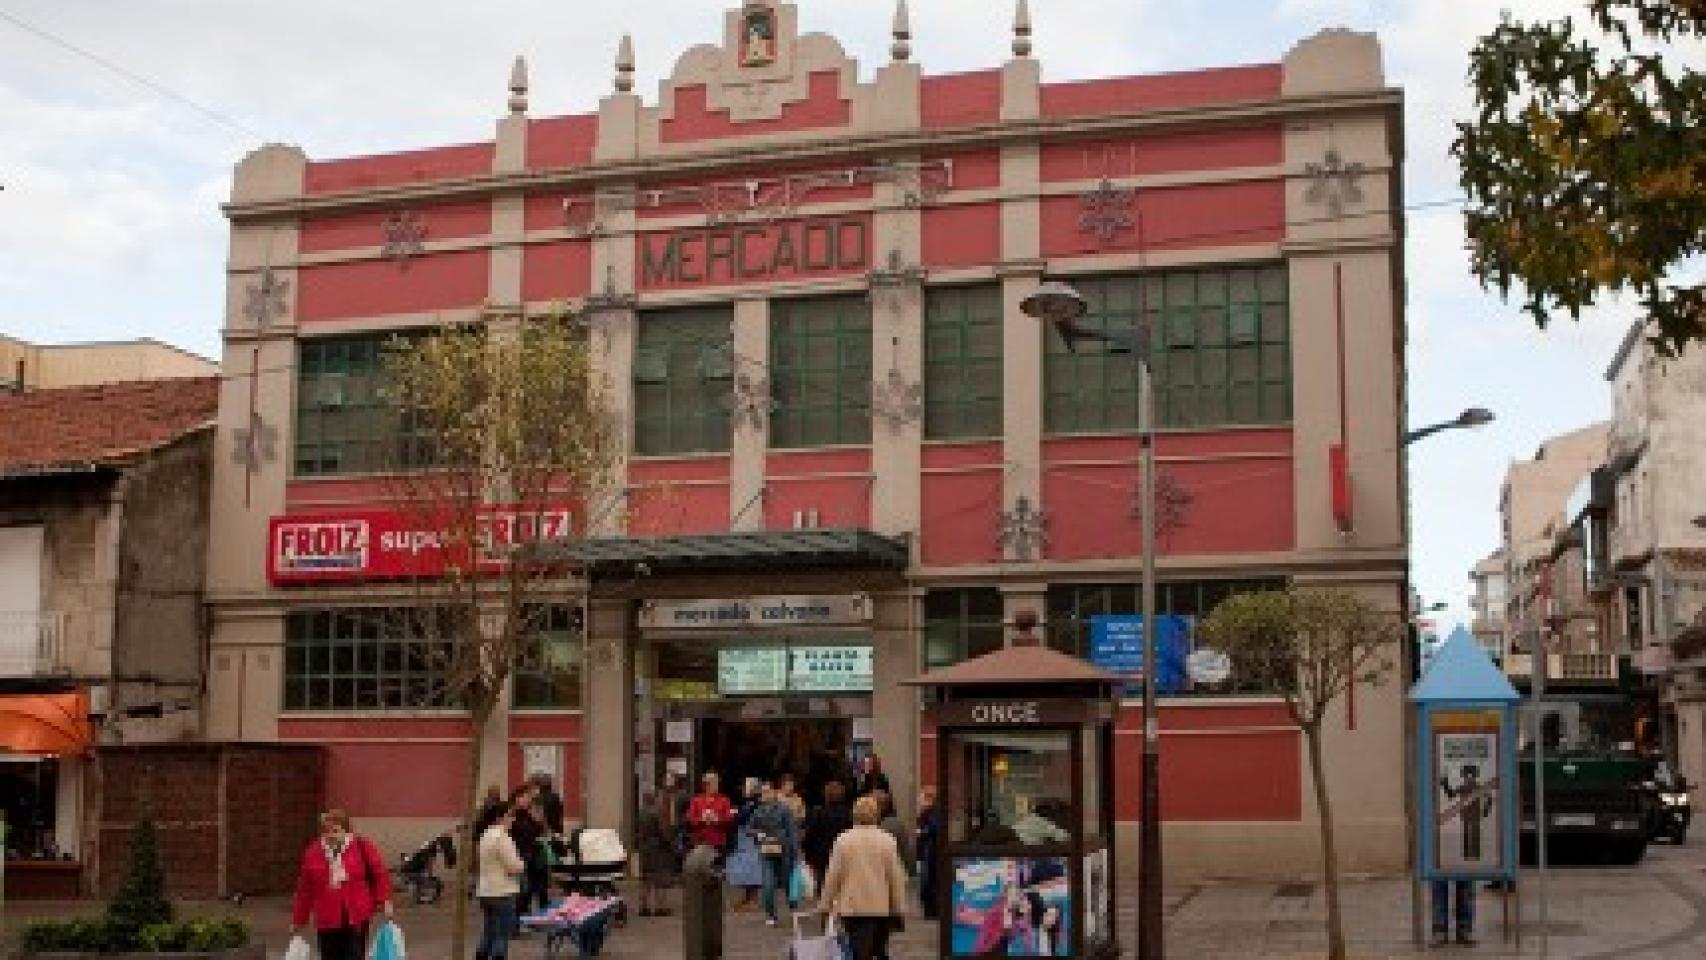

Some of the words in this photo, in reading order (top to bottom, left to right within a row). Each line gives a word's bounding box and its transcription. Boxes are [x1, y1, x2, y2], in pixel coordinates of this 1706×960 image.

[641, 221, 867, 287] MERCADO
[281, 525, 362, 556] FROIZ
[970, 700, 1041, 724] ONCE
